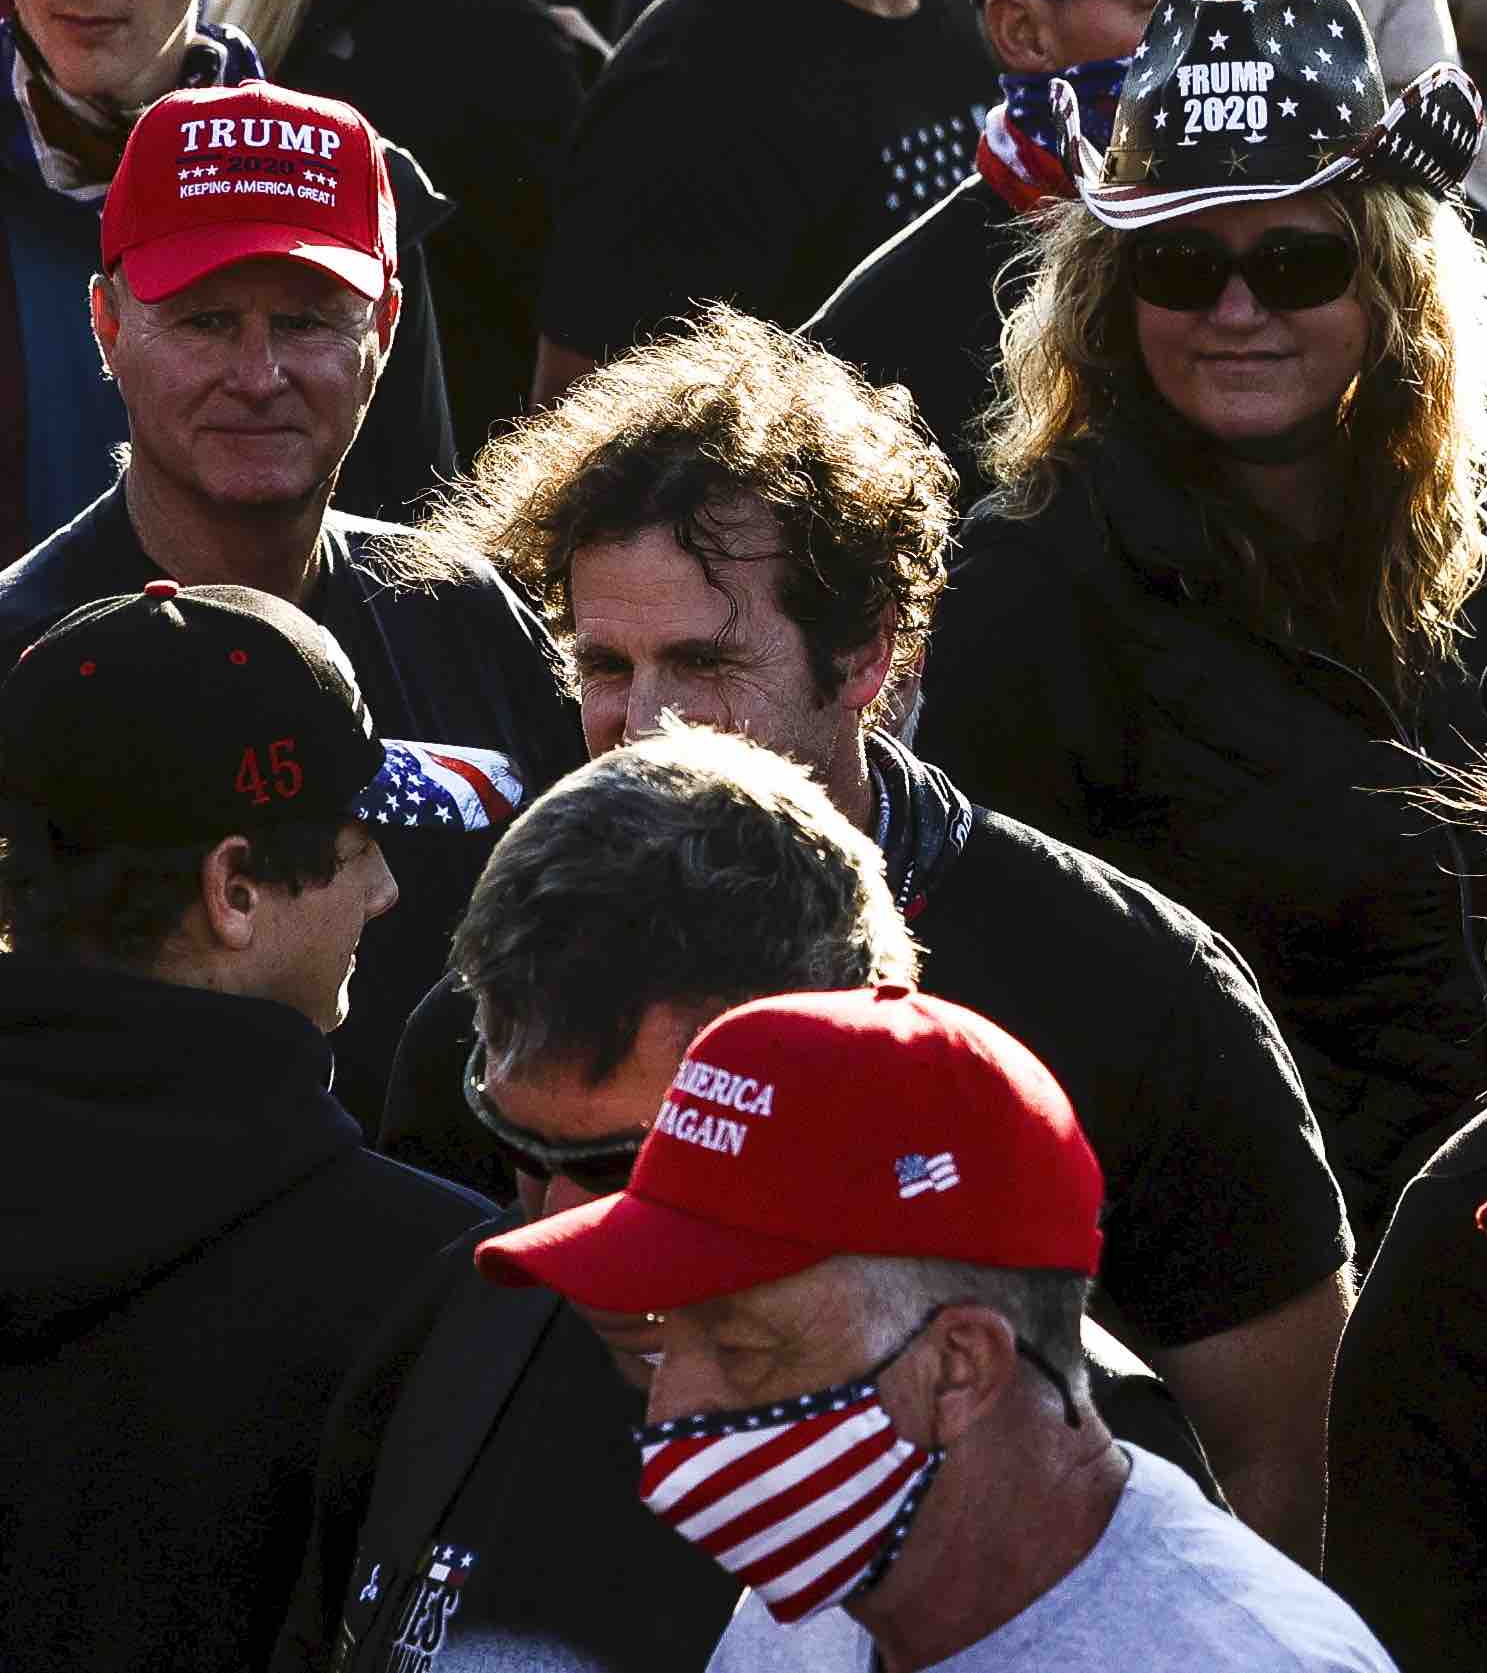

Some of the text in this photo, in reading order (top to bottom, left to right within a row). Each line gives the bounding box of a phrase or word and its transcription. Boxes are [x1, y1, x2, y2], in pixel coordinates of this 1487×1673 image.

[1177, 60, 1275, 97] TRUMP
[1184, 95, 1268, 134] 2020
[180, 118, 341, 160] TRUMP
[180, 180, 232, 199] KEEPING
[234, 179, 295, 198] AMERICA
[233, 736, 303, 807] 45
[655, 1100, 749, 1157] AGAIN
